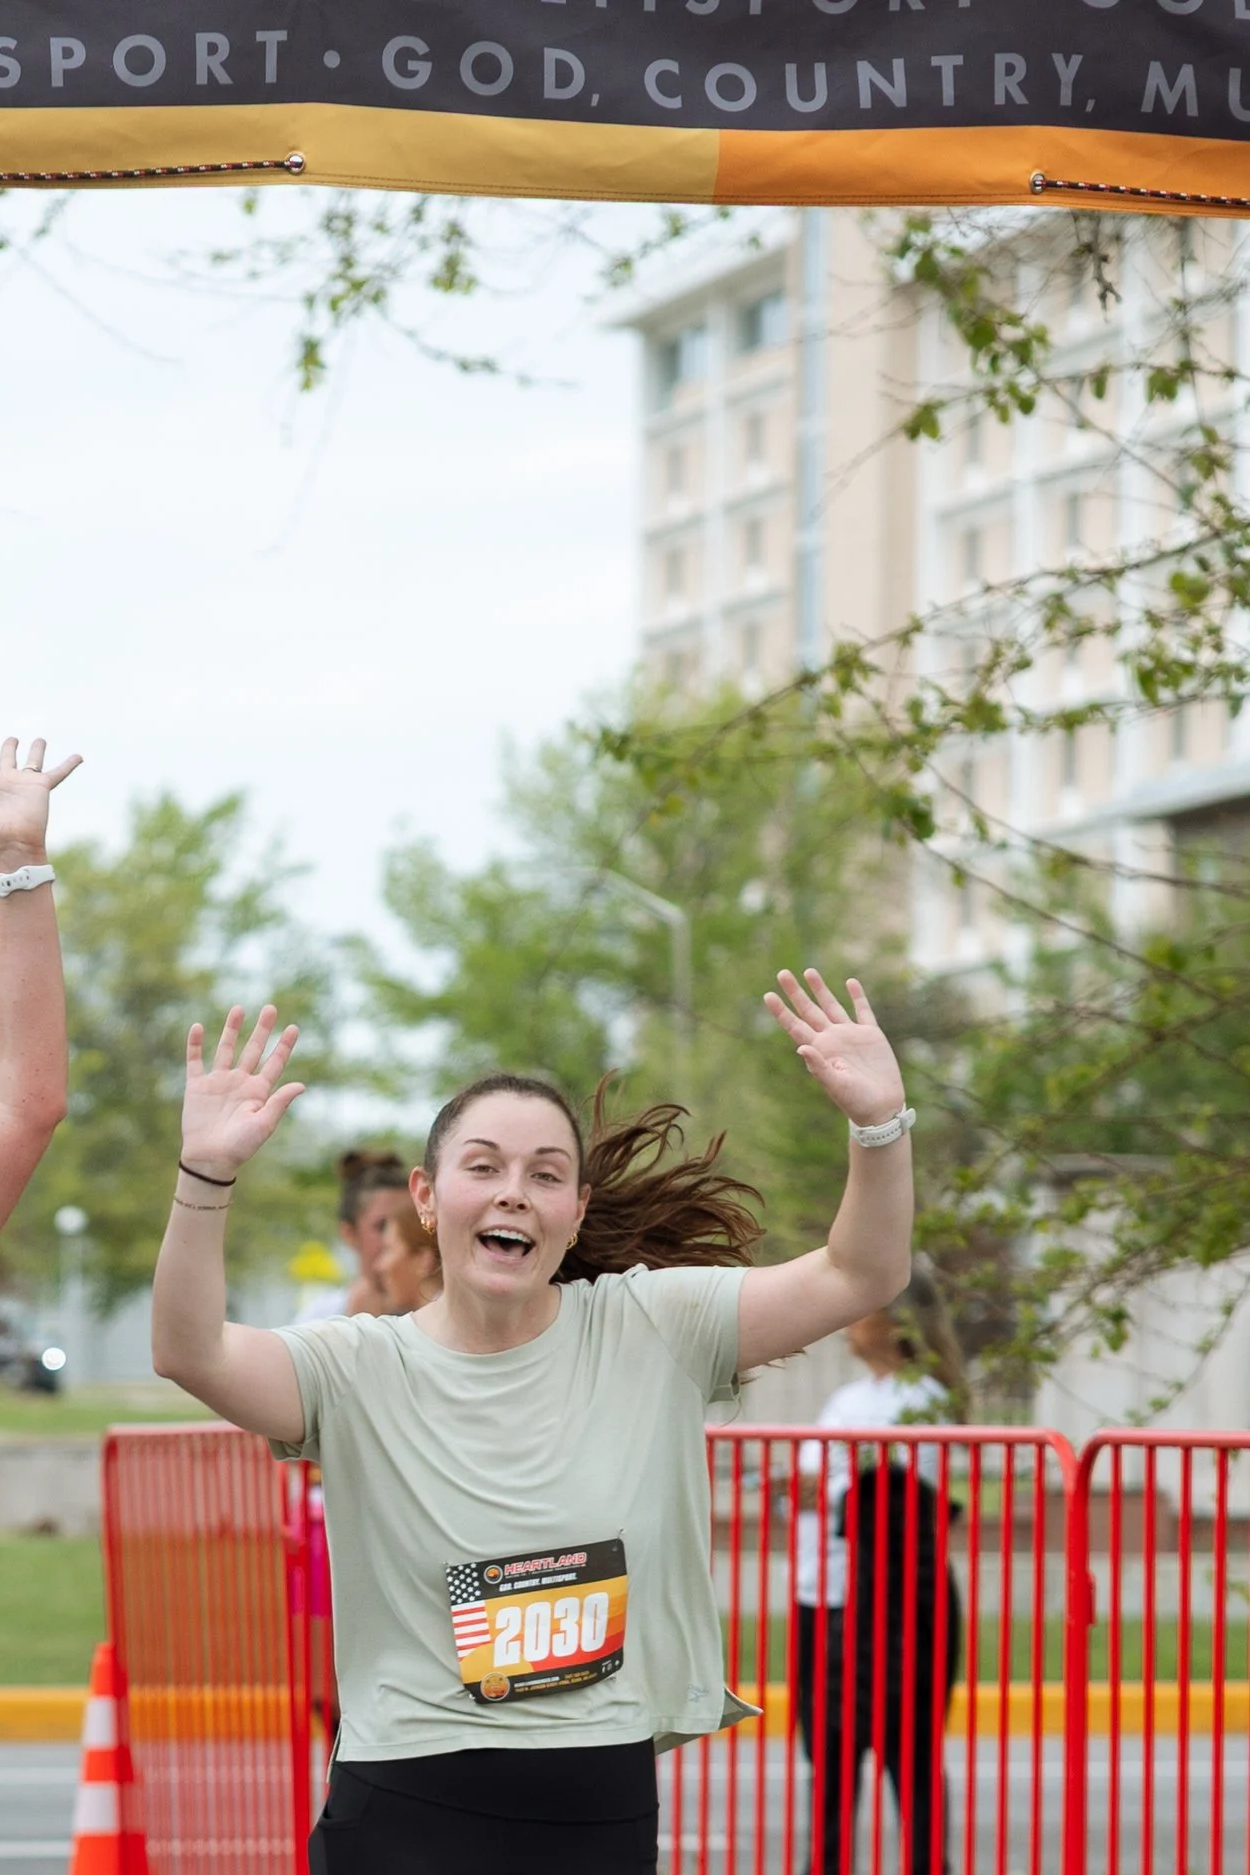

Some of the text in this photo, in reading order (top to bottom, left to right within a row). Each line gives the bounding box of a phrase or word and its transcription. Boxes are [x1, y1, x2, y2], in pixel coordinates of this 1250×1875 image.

[380, 35, 600, 107] GOD,
[643, 53, 1097, 113] COUNTRY,
[504, 1552, 587, 1575] HEARTLAND
[493, 1591, 609, 1668] 2030
